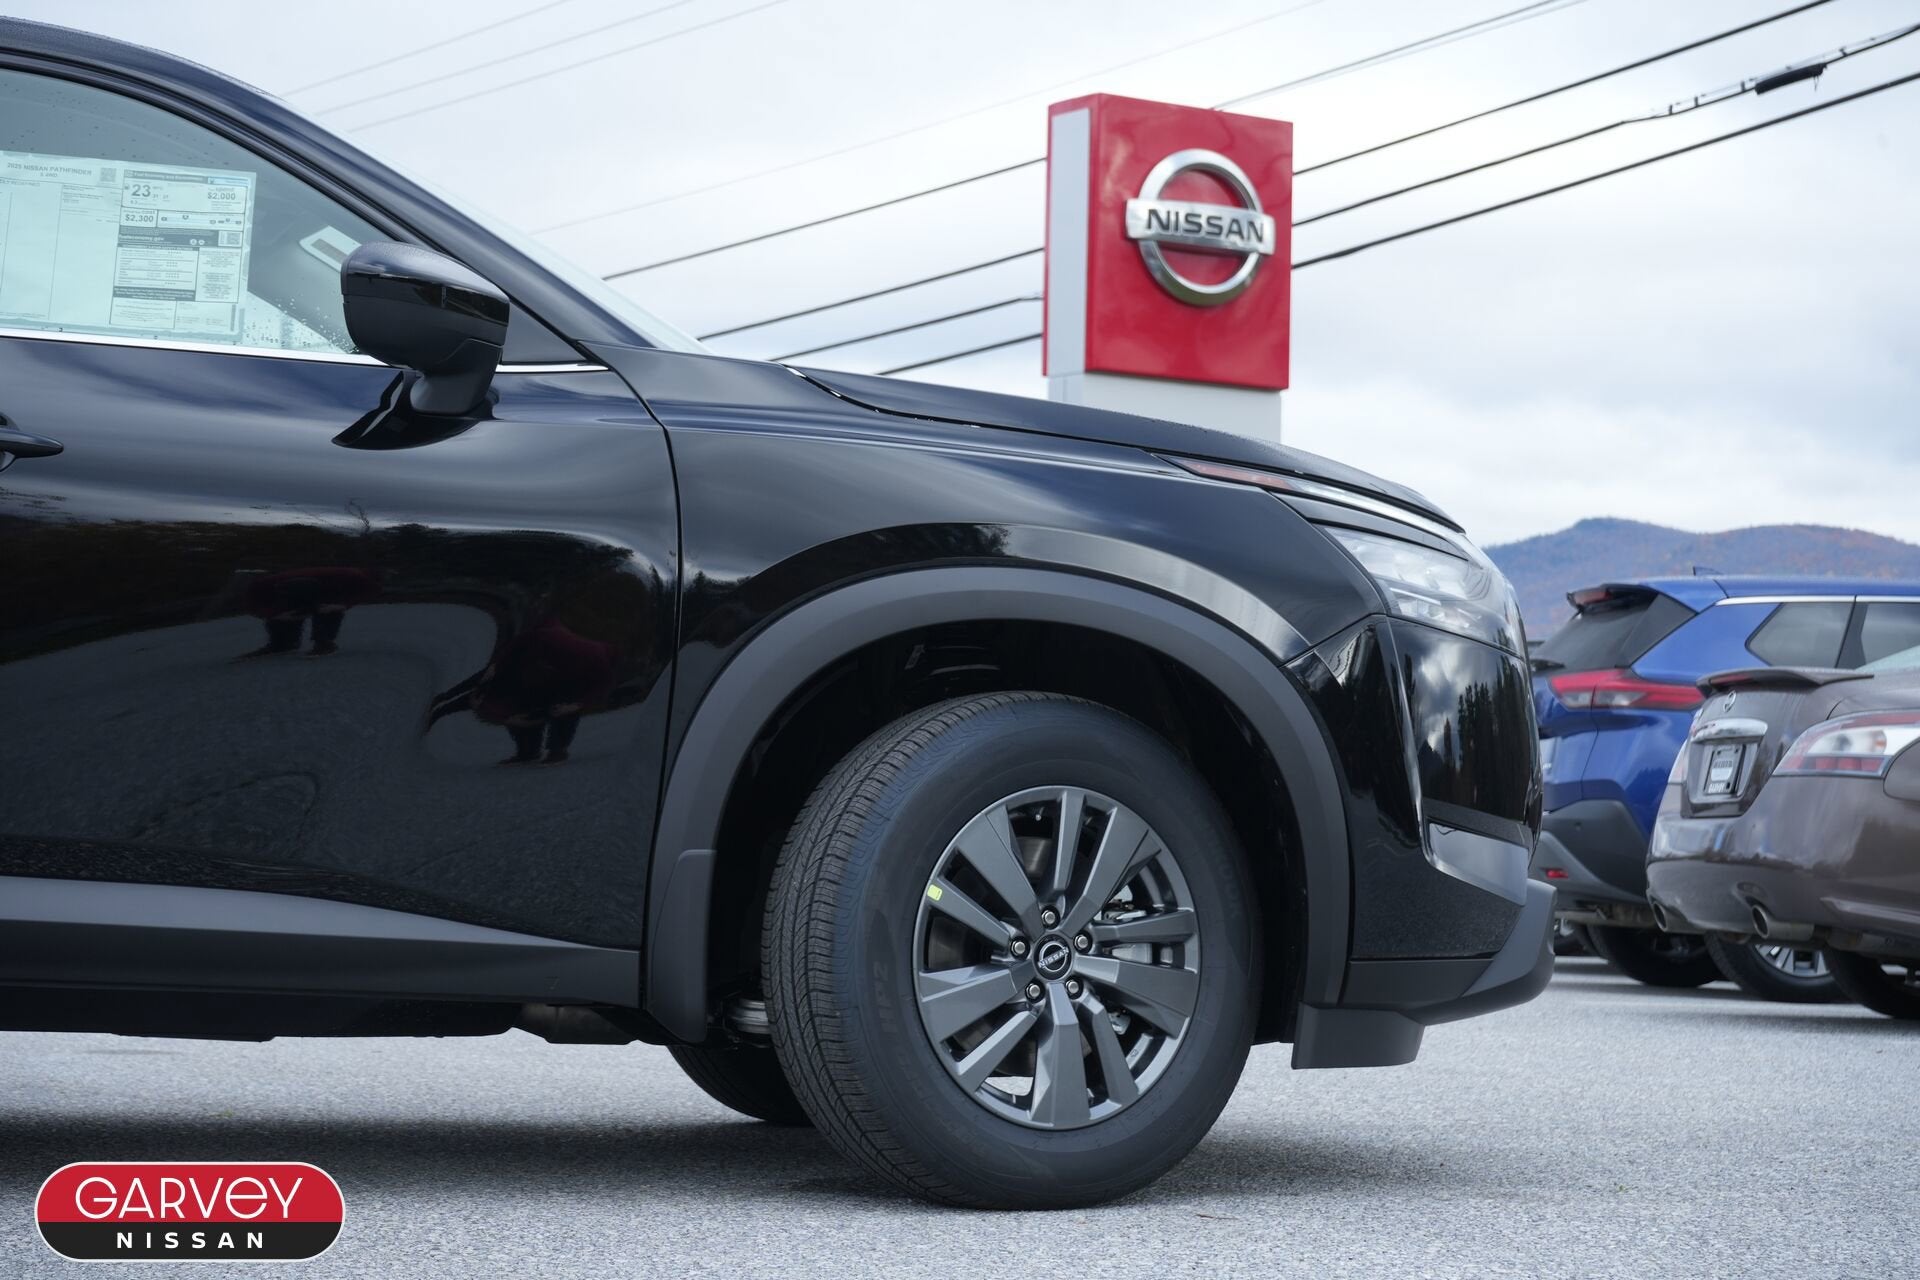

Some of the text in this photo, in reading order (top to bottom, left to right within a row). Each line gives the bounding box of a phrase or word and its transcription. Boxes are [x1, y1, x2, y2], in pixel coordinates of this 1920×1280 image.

[23, 164, 48, 173] NISSAN
[131, 184, 151, 198] 23
[1146, 209, 1264, 243] NISSAN
[1037, 946, 1070, 969] NISSAN
[873, 961, 898, 1034] HP2
